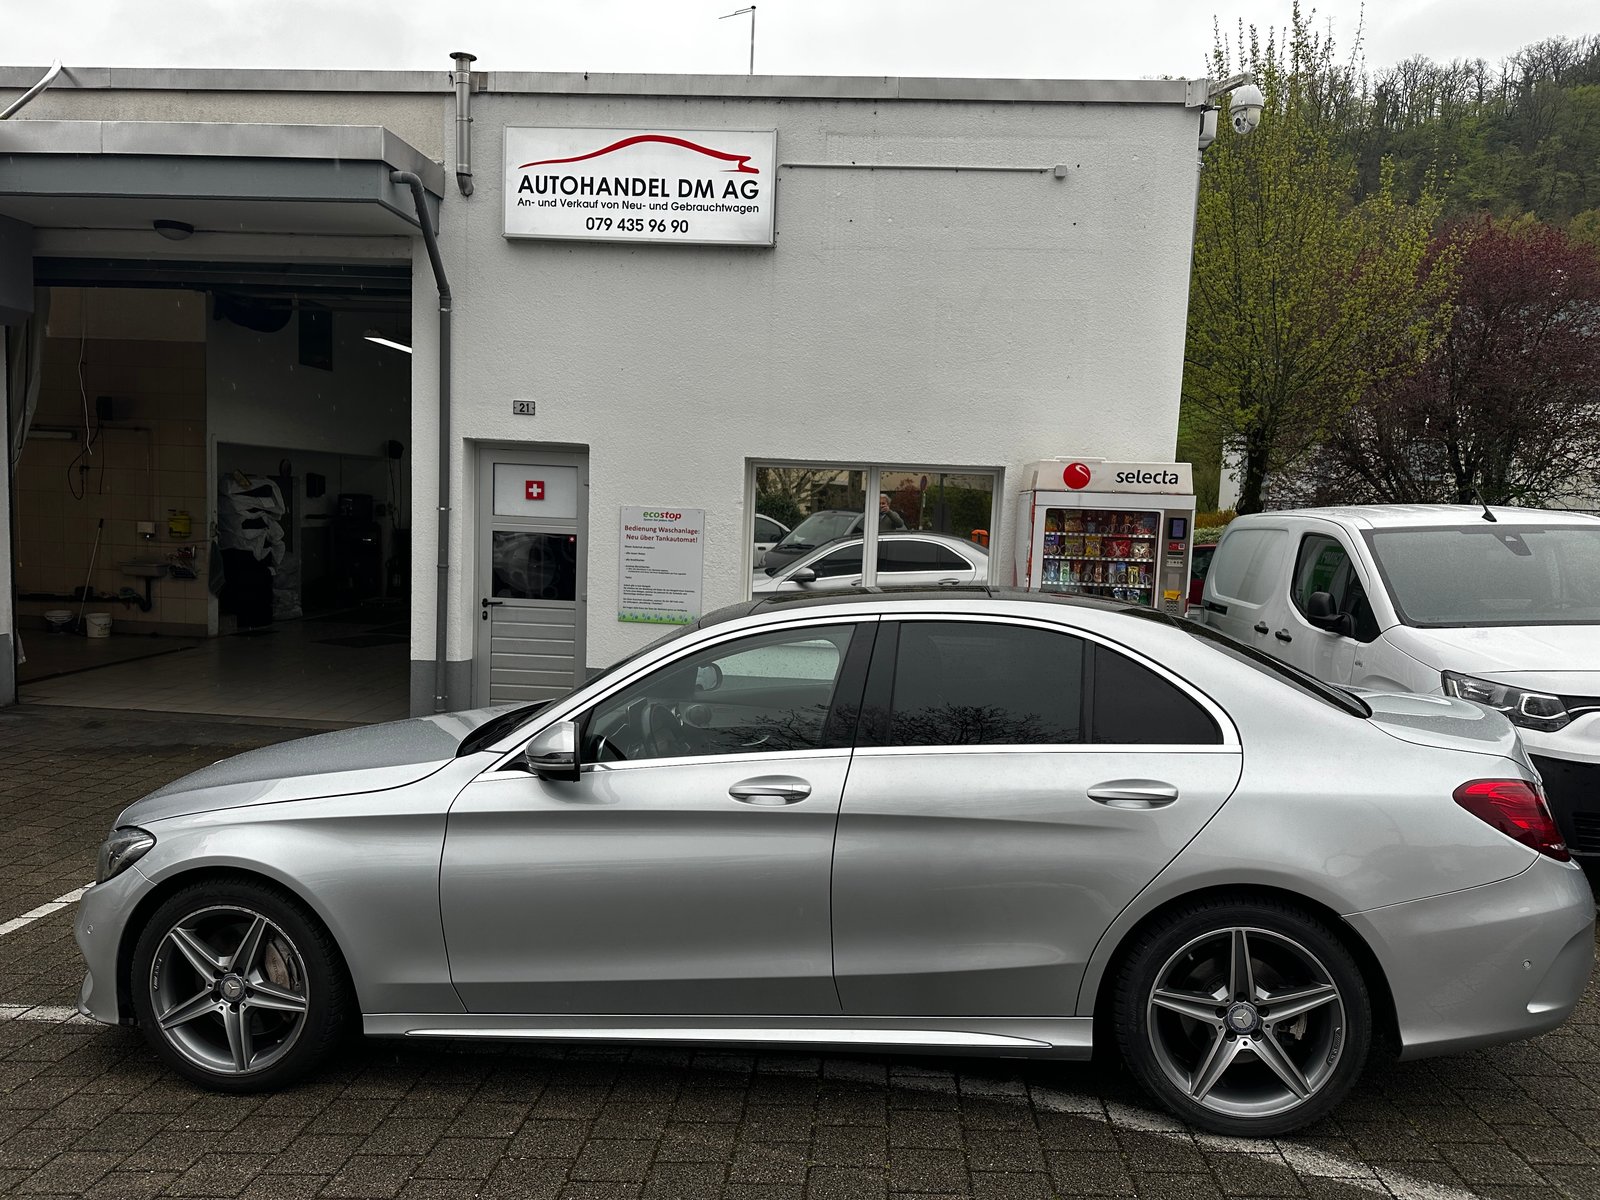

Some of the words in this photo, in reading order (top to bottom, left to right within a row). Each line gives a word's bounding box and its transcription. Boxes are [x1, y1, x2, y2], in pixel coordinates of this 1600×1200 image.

[518, 175, 670, 198] AUTOHANDEL
[678, 179, 714, 199] DM
[721, 179, 760, 200] AG
[517, 197, 535, 207] An-
[537, 198, 557, 208] und
[559, 198, 599, 209] Verkauf
[600, 201, 619, 210] von
[622, 200, 646, 211] Neu-
[649, 201, 668, 211] und
[671, 201, 759, 214] Gebrauchtwagen
[586, 217, 613, 231] 079
[617, 217, 644, 232] 435
[649, 218, 666, 233] 96
[671, 219, 689, 233] 90
[520, 403, 529, 412] 21
[1116, 470, 1178, 485] selecta
[643, 511, 682, 520] ecostop
[624, 525, 657, 534] Bedienung
